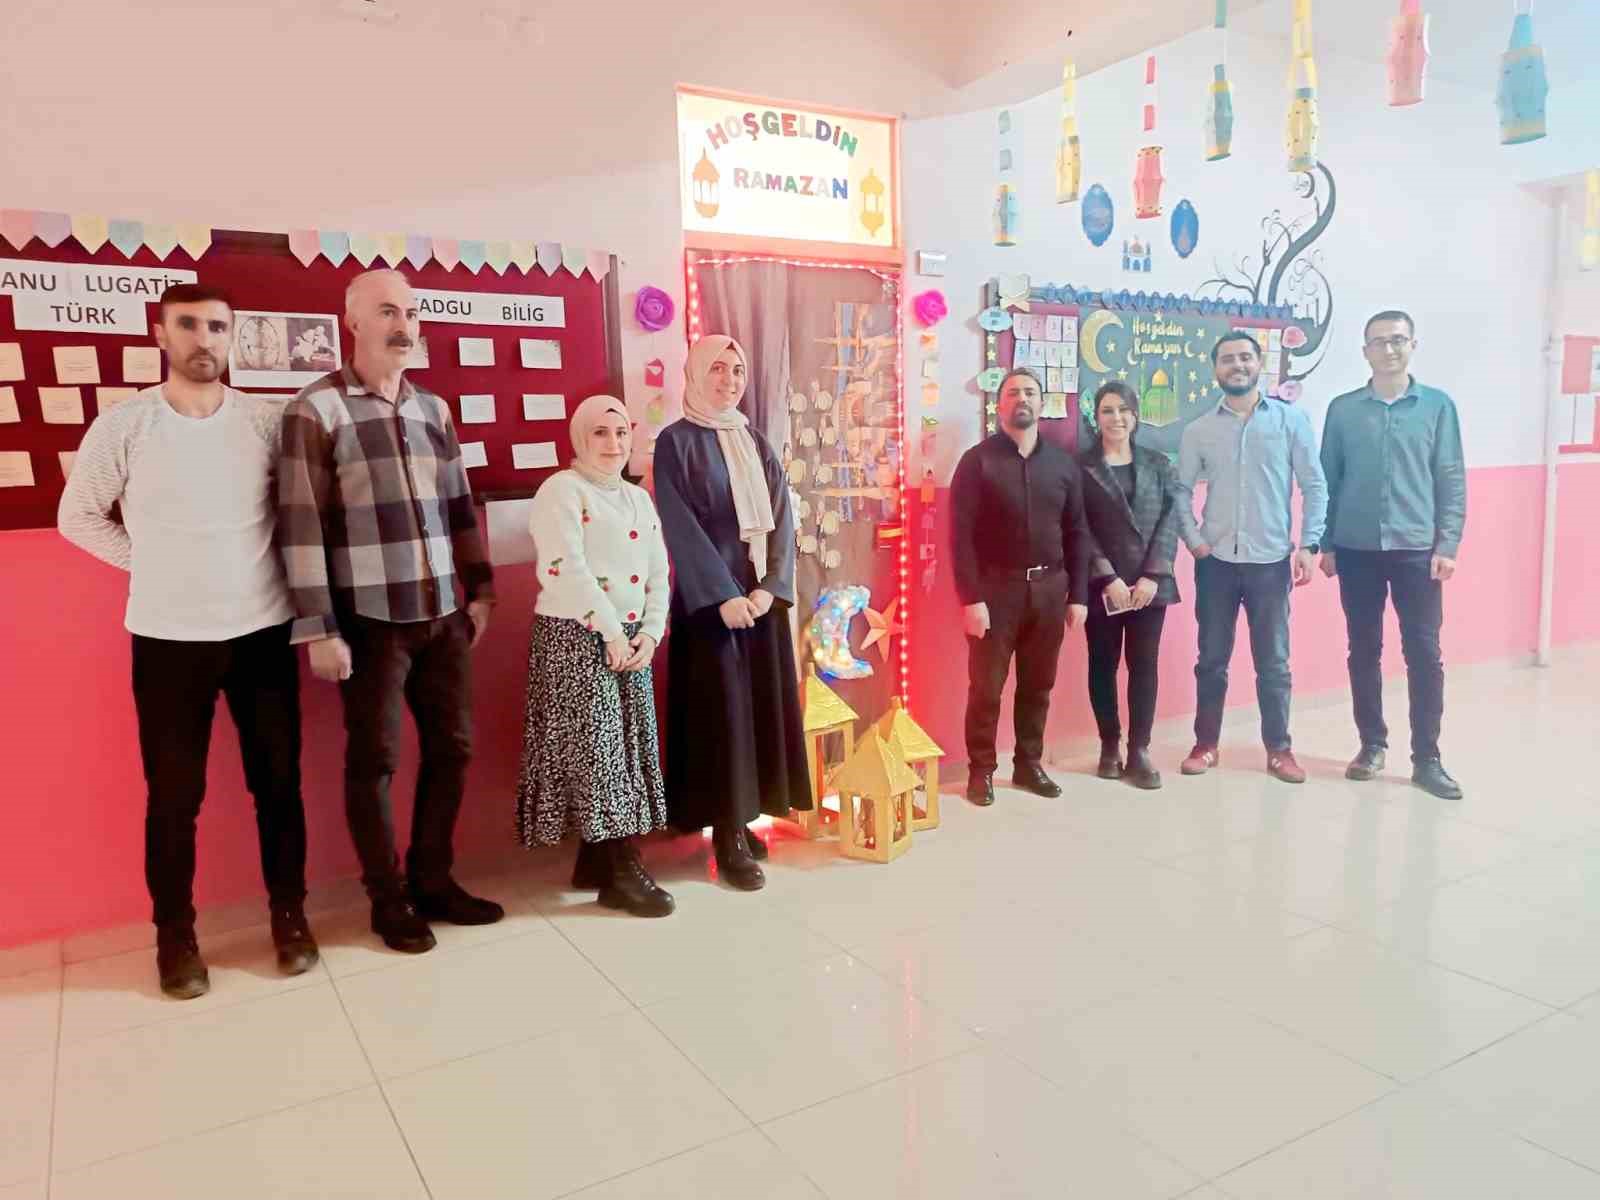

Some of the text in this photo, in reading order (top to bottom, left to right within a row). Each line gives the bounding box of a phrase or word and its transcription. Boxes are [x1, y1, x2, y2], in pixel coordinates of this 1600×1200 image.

[733, 167, 848, 200] RAMAZAN
[85, 274, 183, 295] LUGATİ
[50, 302, 117, 325] TÜRK
[415, 297, 544, 322] ADGU BİLİG
